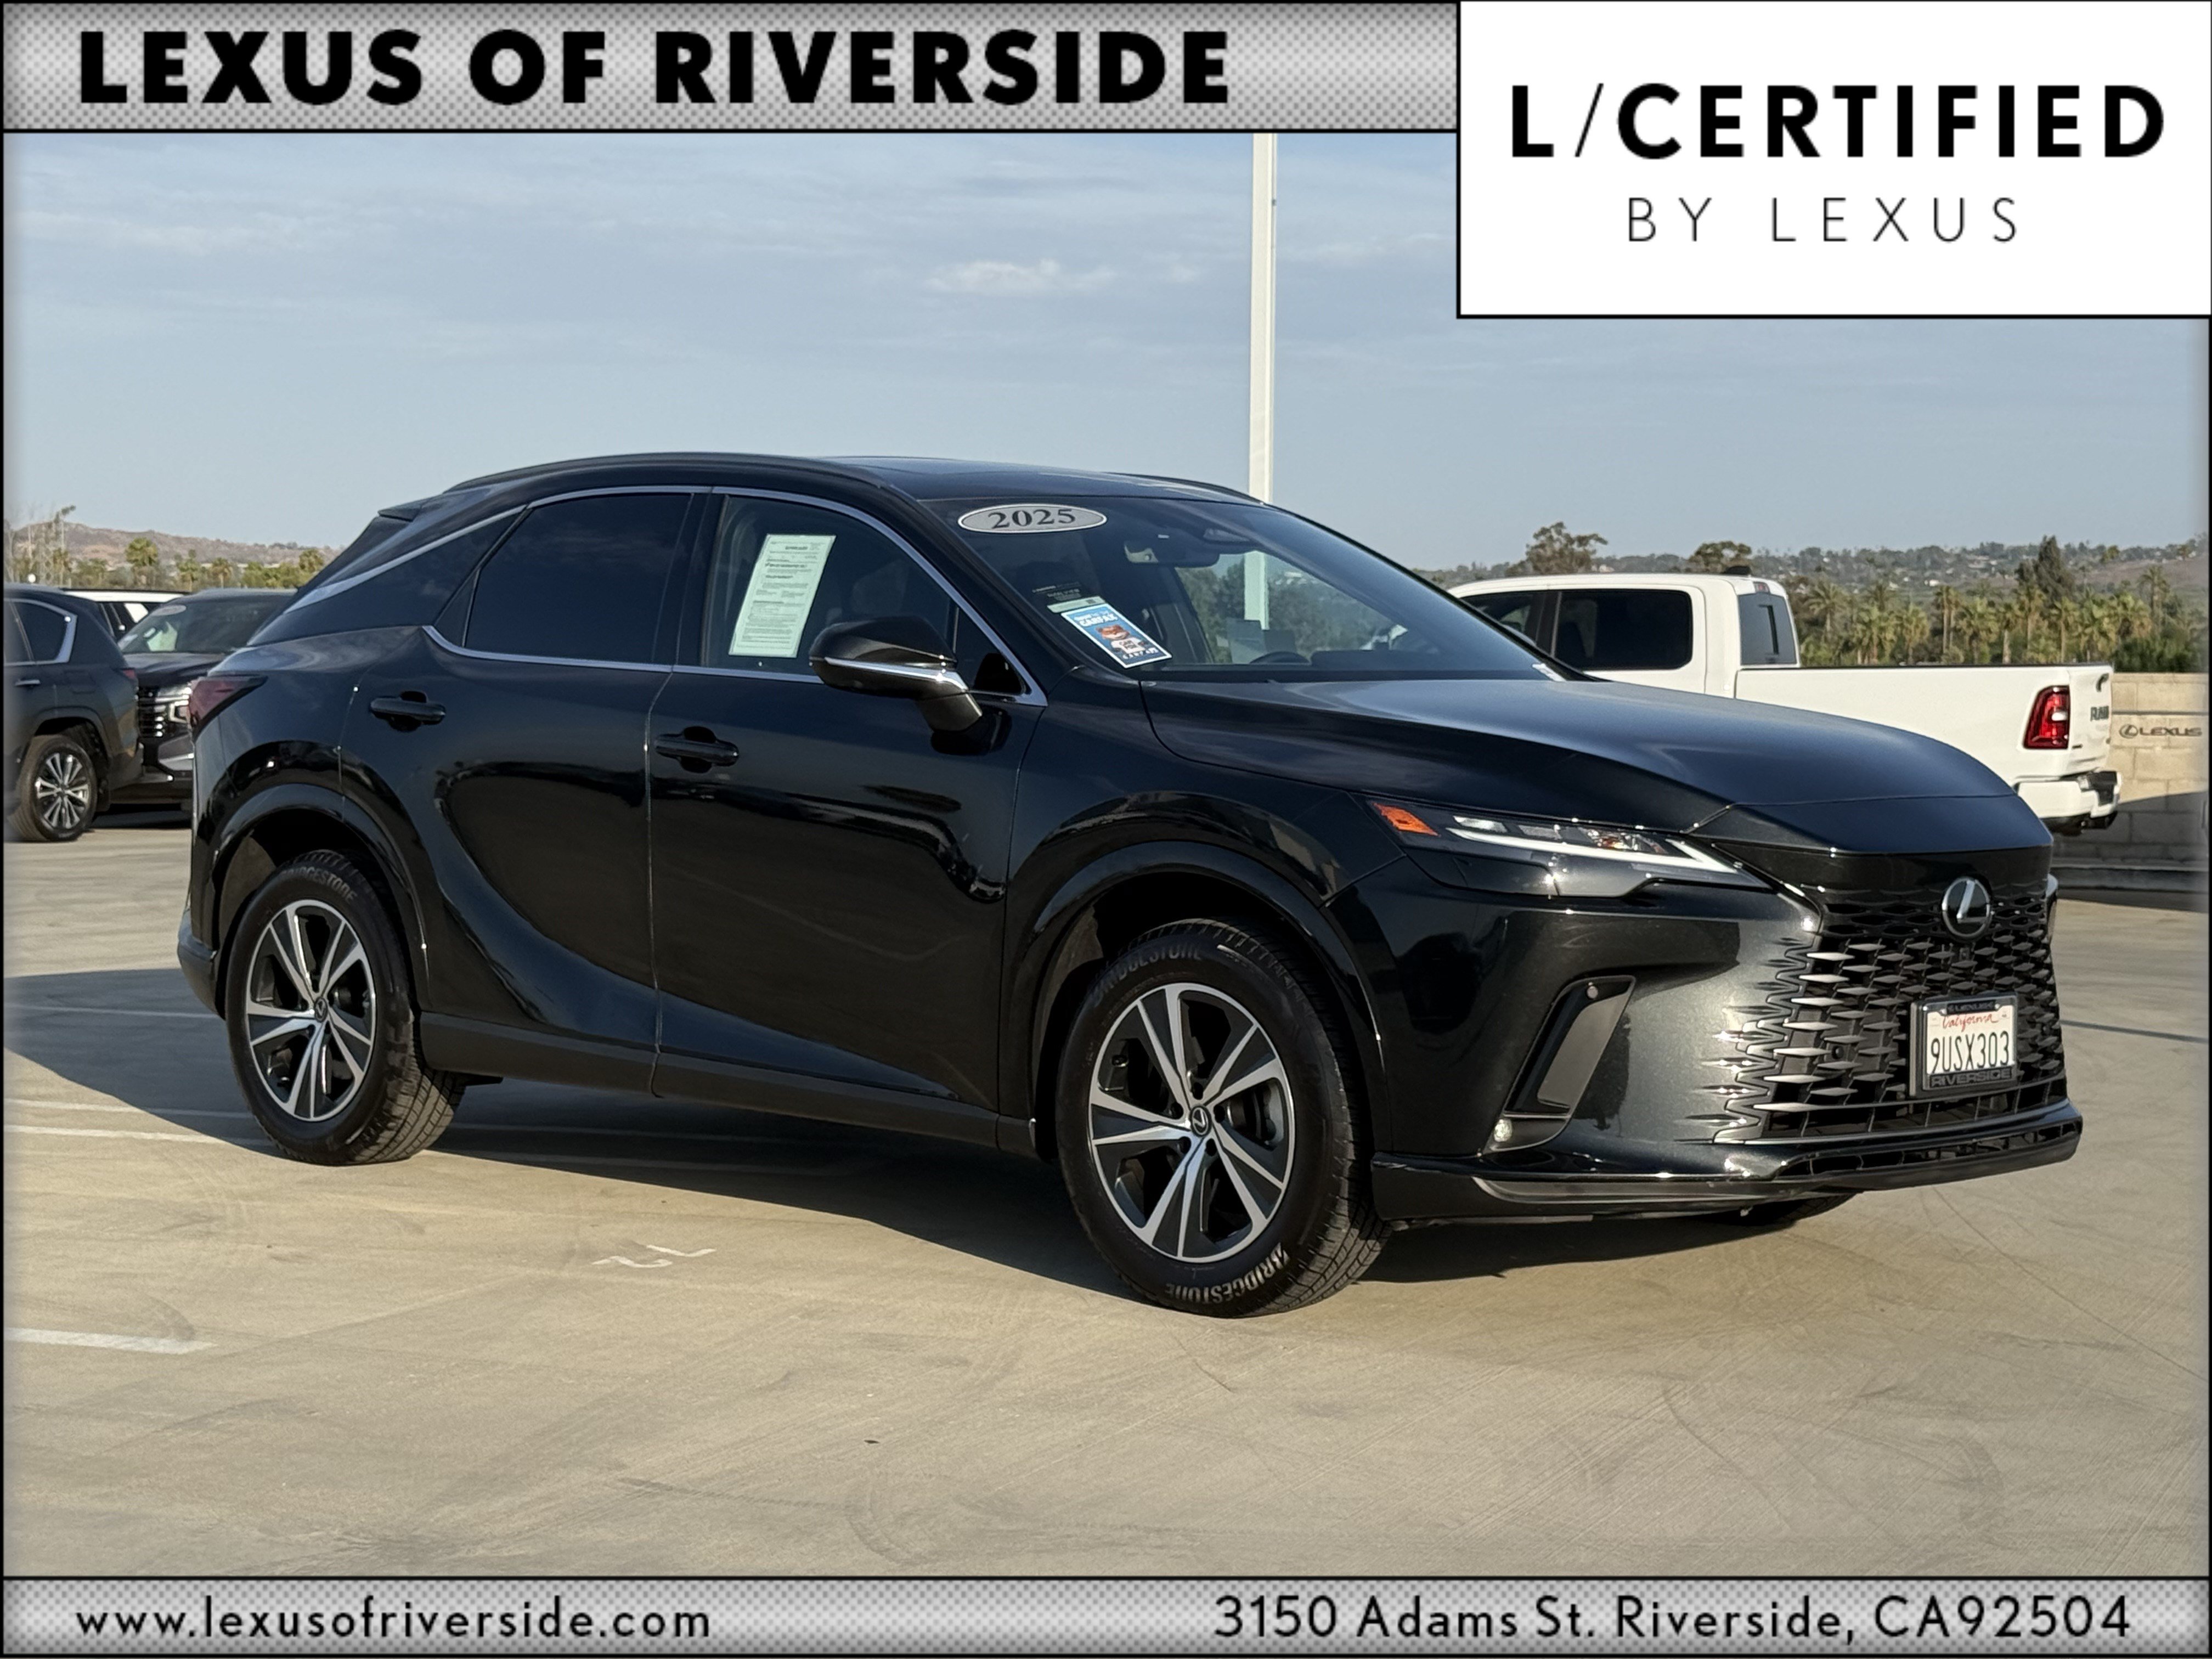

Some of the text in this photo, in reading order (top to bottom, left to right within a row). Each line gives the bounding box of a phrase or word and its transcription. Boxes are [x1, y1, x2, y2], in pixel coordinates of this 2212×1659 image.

[988, 509, 1076, 528] 2025
[2140, 727, 2203, 736] LEXUS
[1943, 1013, 1999, 1032] California
[1931, 1030, 2010, 1074] 9USX303
[1931, 1068, 2011, 1087] RIVERSIDE
[1165, 1242, 1291, 1305] BRIDGESTONE
